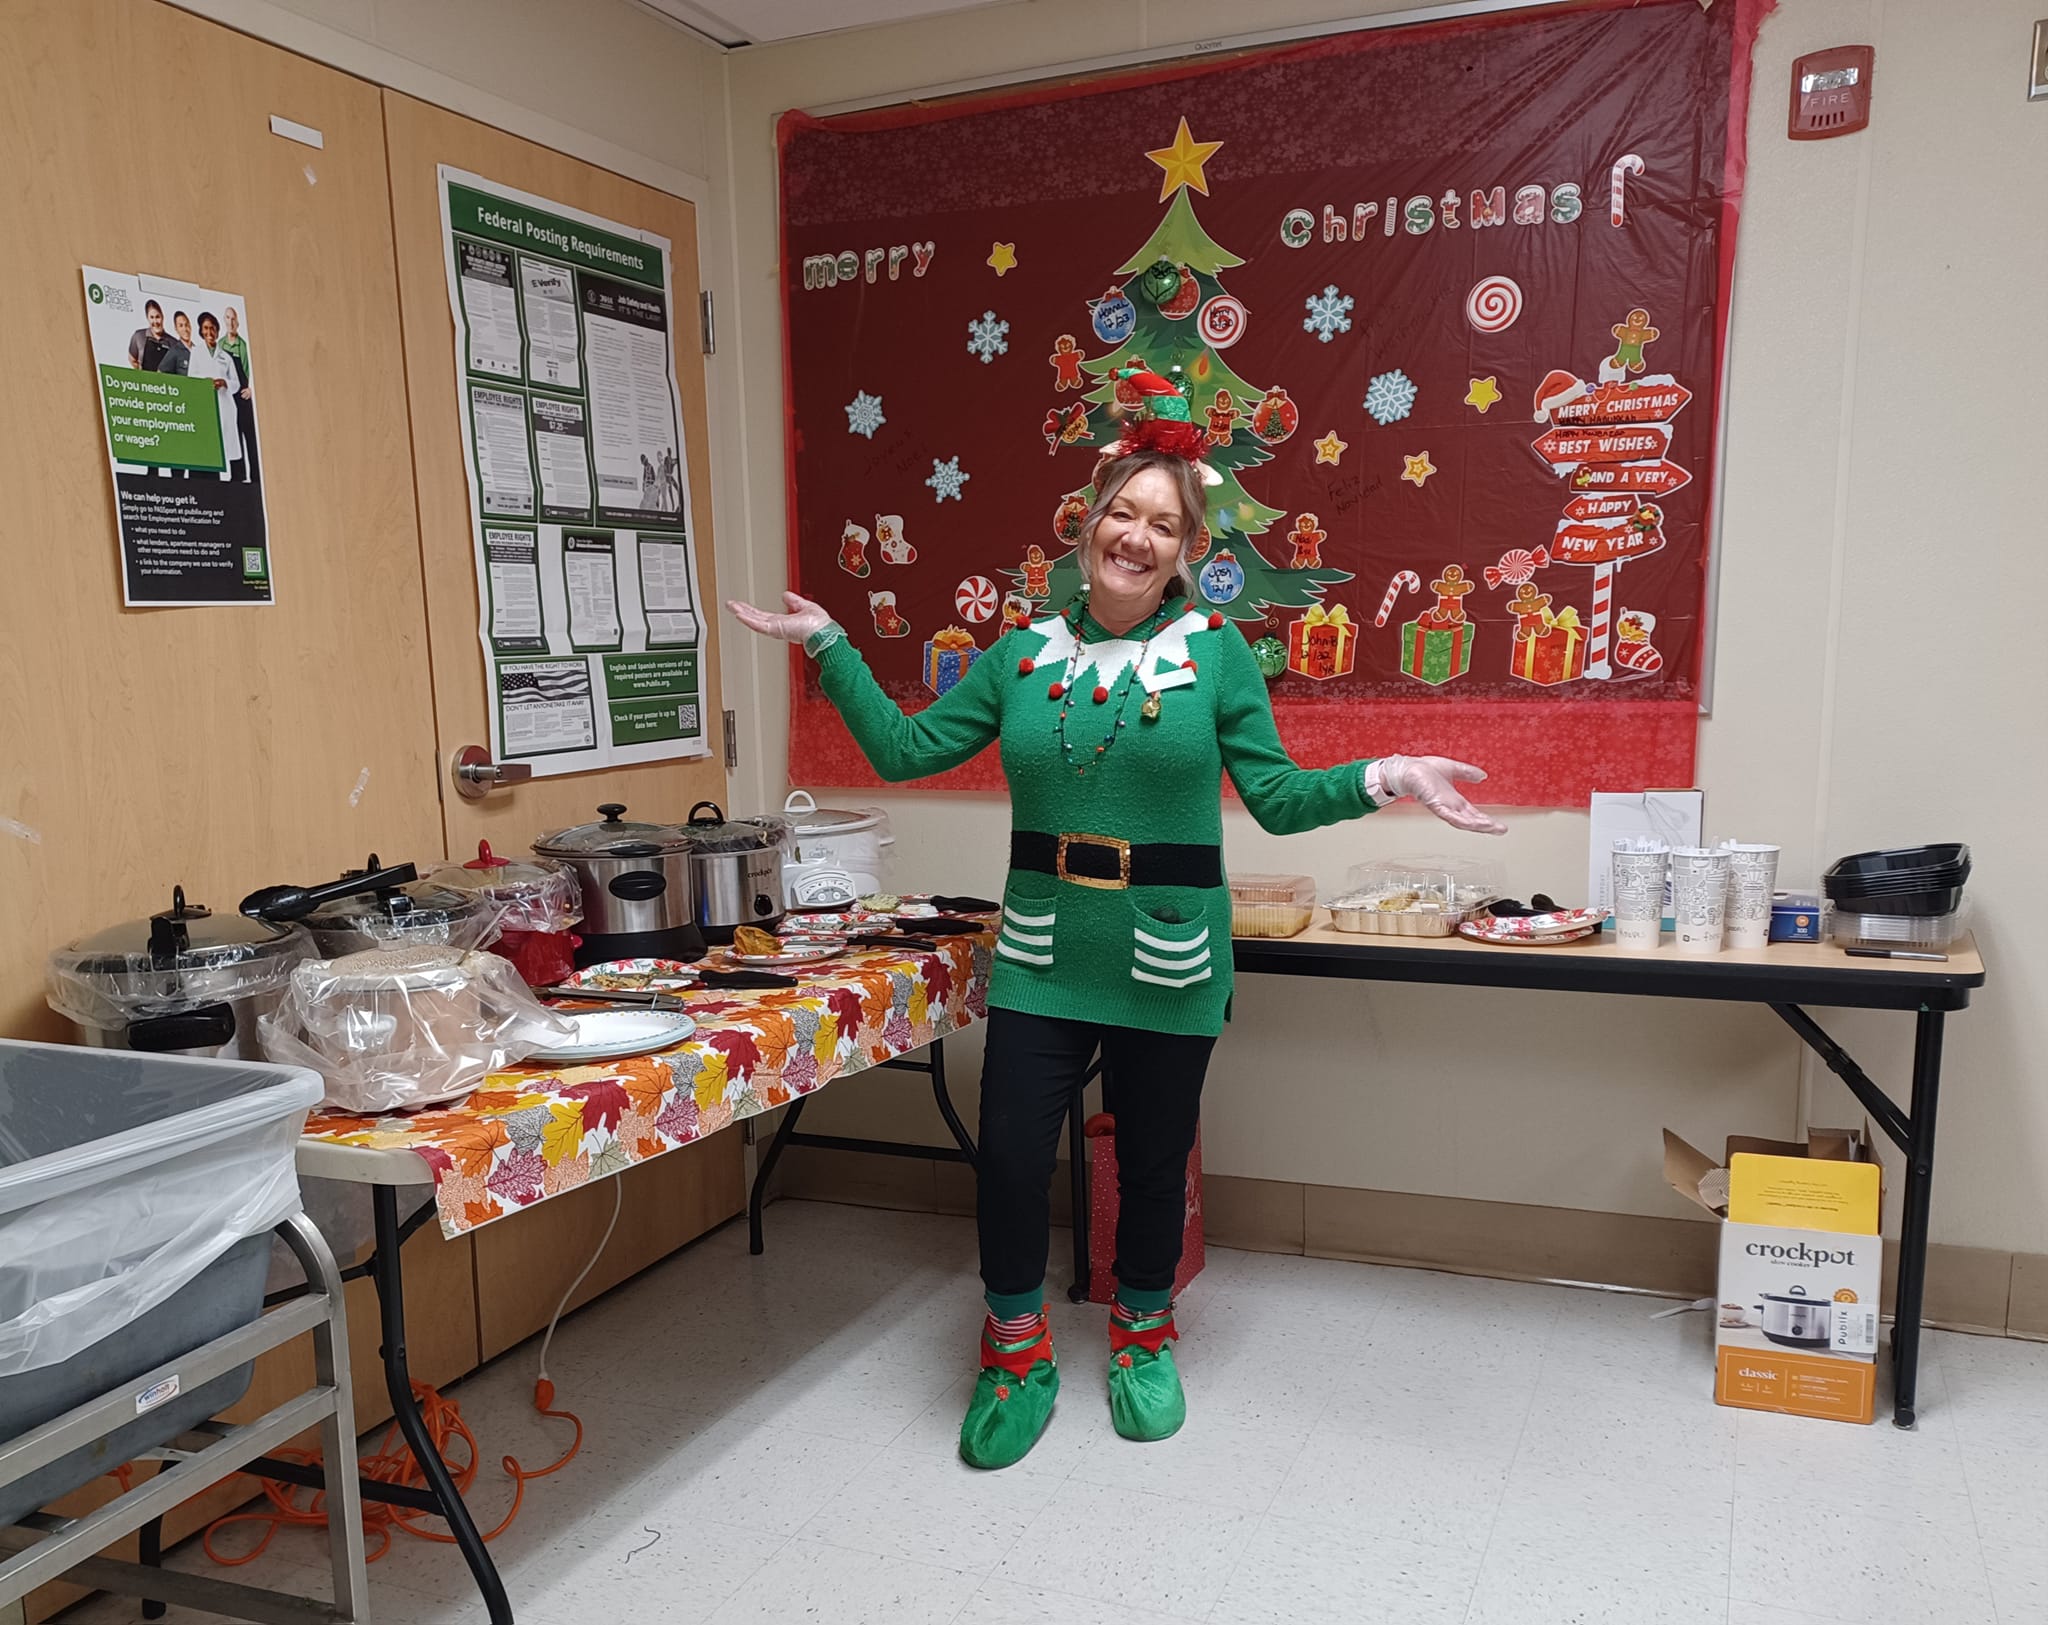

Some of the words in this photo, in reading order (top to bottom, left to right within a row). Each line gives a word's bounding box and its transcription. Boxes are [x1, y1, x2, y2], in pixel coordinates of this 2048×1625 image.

[1810, 93, 1849, 107] FIRE
[477, 207, 523, 235] Federal
[526, 221, 569, 252] Posting
[571, 235, 645, 271] Requirements
[106, 375, 118, 387] Do
[121, 379, 140, 393] you
[142, 383, 166, 395] need
[168, 385, 179, 396] to
[474, 390, 502, 402] EMPLOYEE
[503, 395, 522, 406] RIGHTS
[109, 396, 144, 410] provide
[147, 401, 174, 413] proof
[176, 403, 186, 414] of
[536, 401, 560, 411] EMPLOYEE
[562, 404, 580, 414] RIGHTS
[1558, 403, 1600, 419] MERRY
[1606, 393, 1678, 413] CHRISTMAS
[111, 415, 132, 426] your
[134, 418, 195, 432] employment
[114, 433, 123, 443] or
[125, 434, 160, 448] wages?
[1558, 439, 1591, 454] BEST
[1599, 436, 1653, 452] WISHES
[1590, 472, 1615, 484] AND
[1621, 472, 1629, 483] A
[1636, 471, 1669, 484] VERY
[121, 491, 132, 500] We
[146, 493, 161, 504] help
[161, 496, 174, 505] you
[175, 496, 188, 505] get
[189, 495, 198, 504] it.
[122, 504, 139, 512] Simply
[1588, 500, 1632, 514] HAPPY
[148, 515, 181, 524] Employment
[181, 516, 212, 525] Verification
[489, 532, 513, 541] EMPLOYEE
[514, 533, 531, 541] RIGHTS
[1562, 536, 1599, 551] NEW
[1606, 533, 1644, 551] YEAR
[170, 540, 197, 549] apartment
[198, 541, 225, 550] managers
[169, 560, 192, 569] company
[218, 561, 234, 569] verify
[141, 568, 152, 576] your
[1208, 566, 1231, 578] Josh
[609, 664, 626, 672] English
[627, 663, 636, 671] and
[638, 662, 656, 671] Spanish
[614, 672, 634, 681] required
[634, 672, 652, 680] posters
[506, 703, 523, 712] DON'T
[614, 714, 628, 722] Check
[633, 713, 644, 721] your
[644, 712, 658, 720] poster
[663, 711, 670, 719] up
[1746, 1242, 1855, 1268] crockpot
[1738, 1367, 1777, 1380] classic
